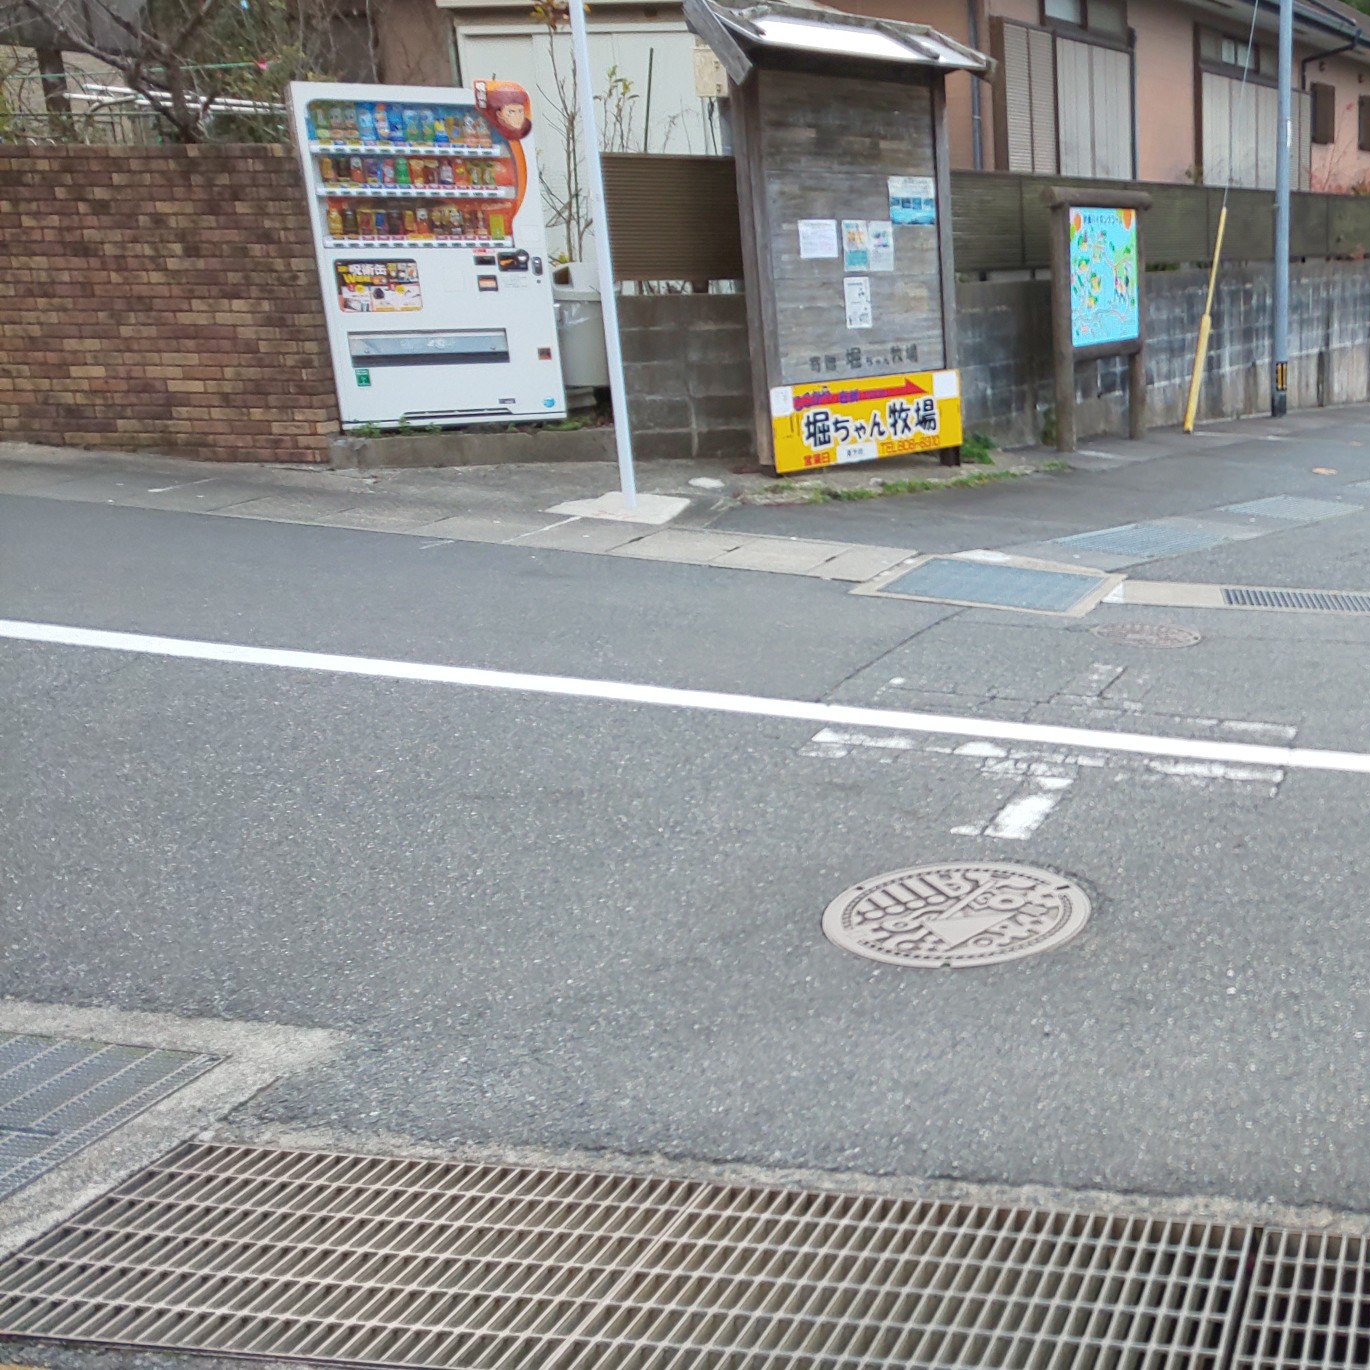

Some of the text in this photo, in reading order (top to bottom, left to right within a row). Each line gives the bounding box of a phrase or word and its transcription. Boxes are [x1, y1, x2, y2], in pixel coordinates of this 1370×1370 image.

[846, 343, 918, 369] 堀ちゃん牧場
[804, 398, 937, 447] 堀ちゃん牧場
